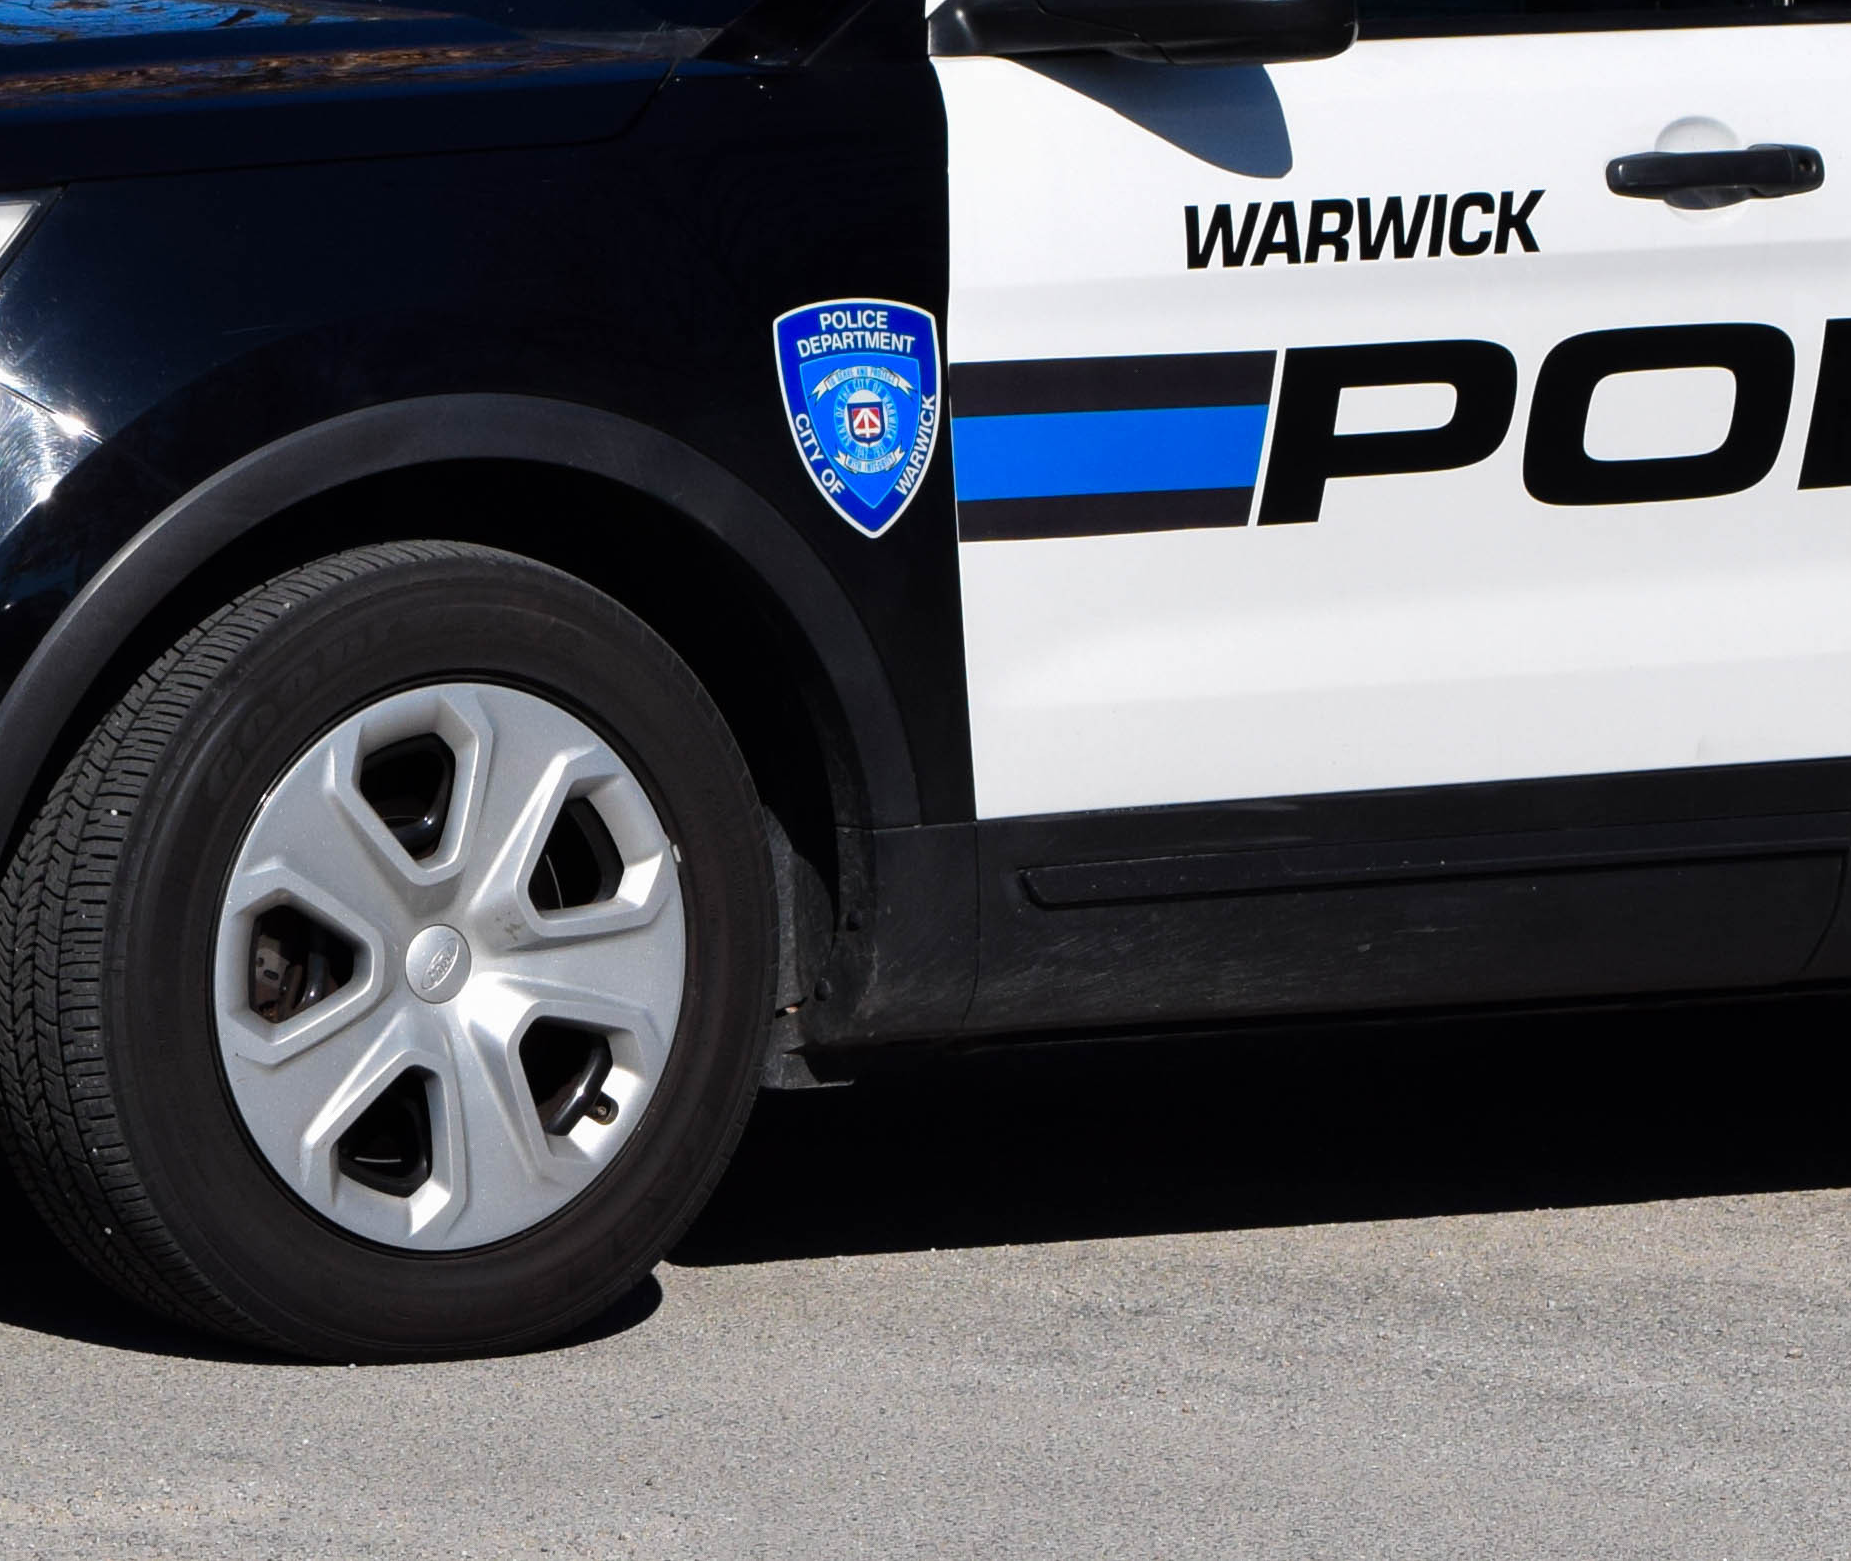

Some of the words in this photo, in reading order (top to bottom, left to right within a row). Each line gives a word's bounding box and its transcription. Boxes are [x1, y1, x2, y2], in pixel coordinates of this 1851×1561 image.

[1184, 189, 1546, 270] WARWICK
[796, 331, 915, 358] DEPARTMENT
[818, 309, 889, 330] POLICE
[795, 413, 824, 461] CITY
[821, 469, 846, 495] OF
[894, 394, 935, 496] WARWICK
